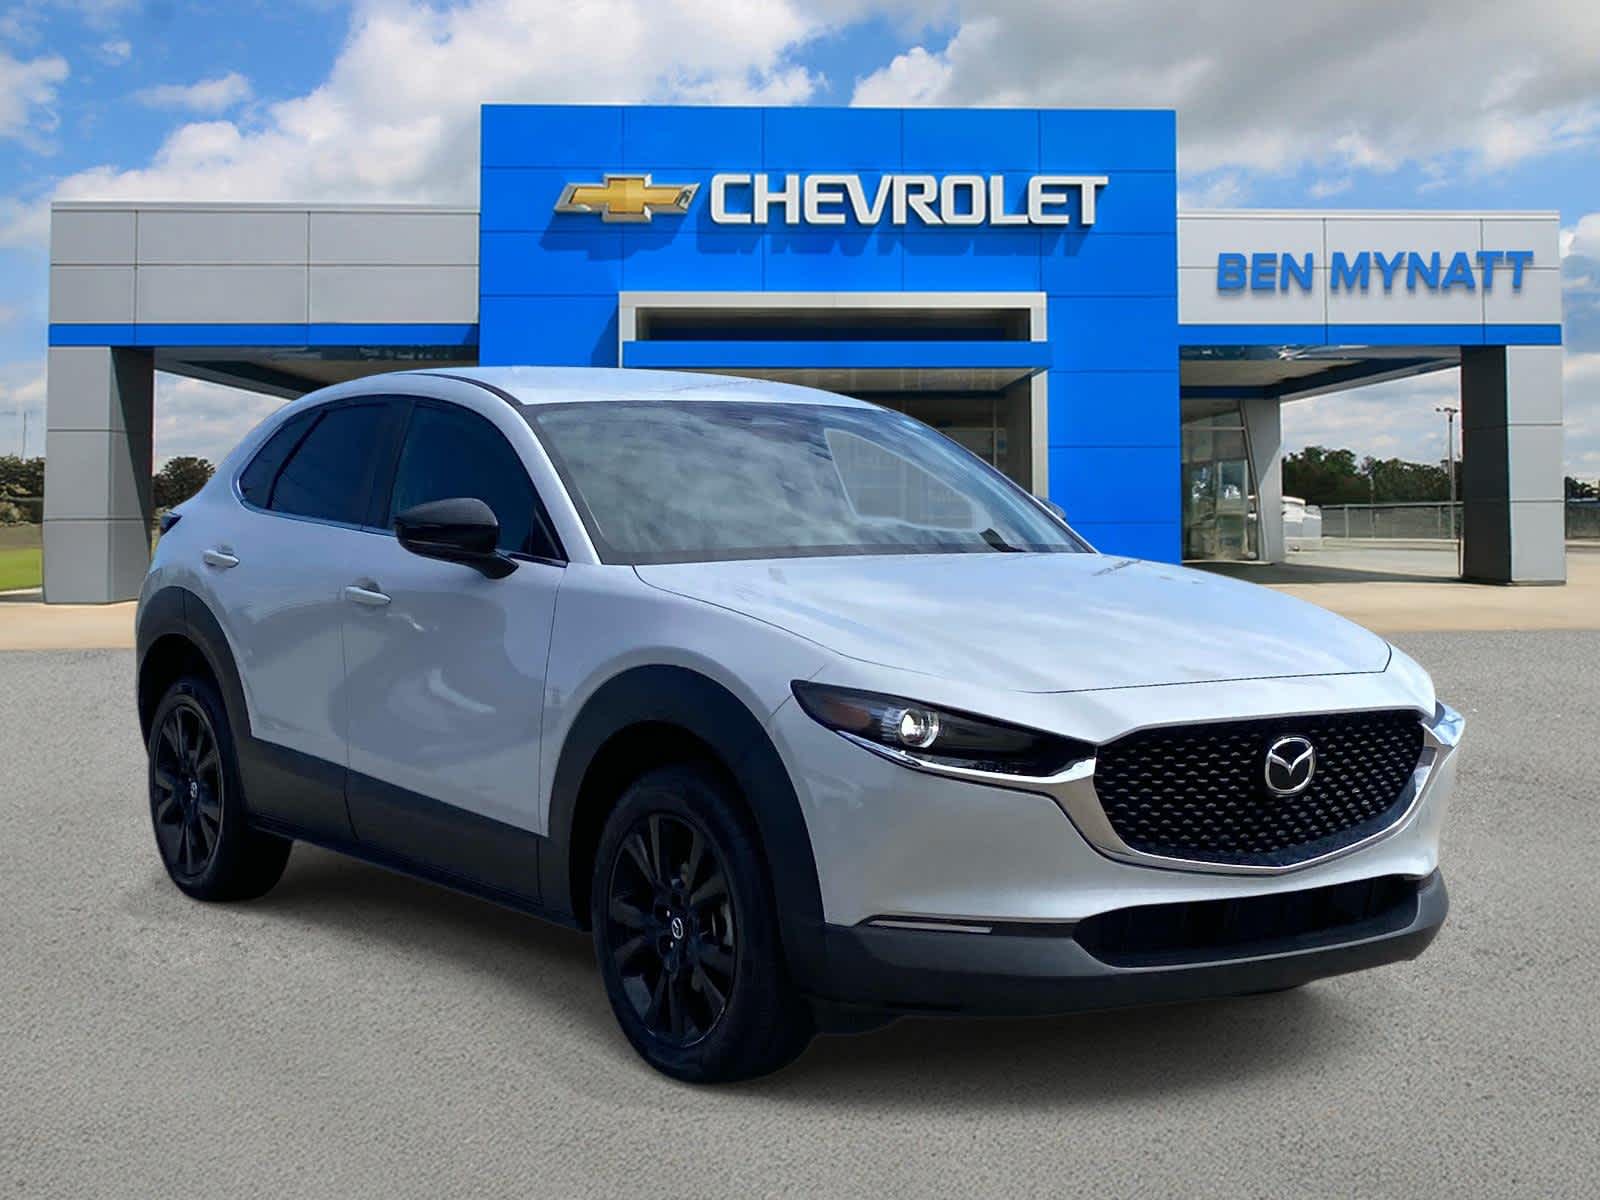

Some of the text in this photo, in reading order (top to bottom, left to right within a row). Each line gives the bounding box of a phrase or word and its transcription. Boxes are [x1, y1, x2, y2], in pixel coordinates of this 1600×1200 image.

[710, 173, 1109, 225] CHEVROLET
[1216, 250, 1534, 291] BEN MYNATT
